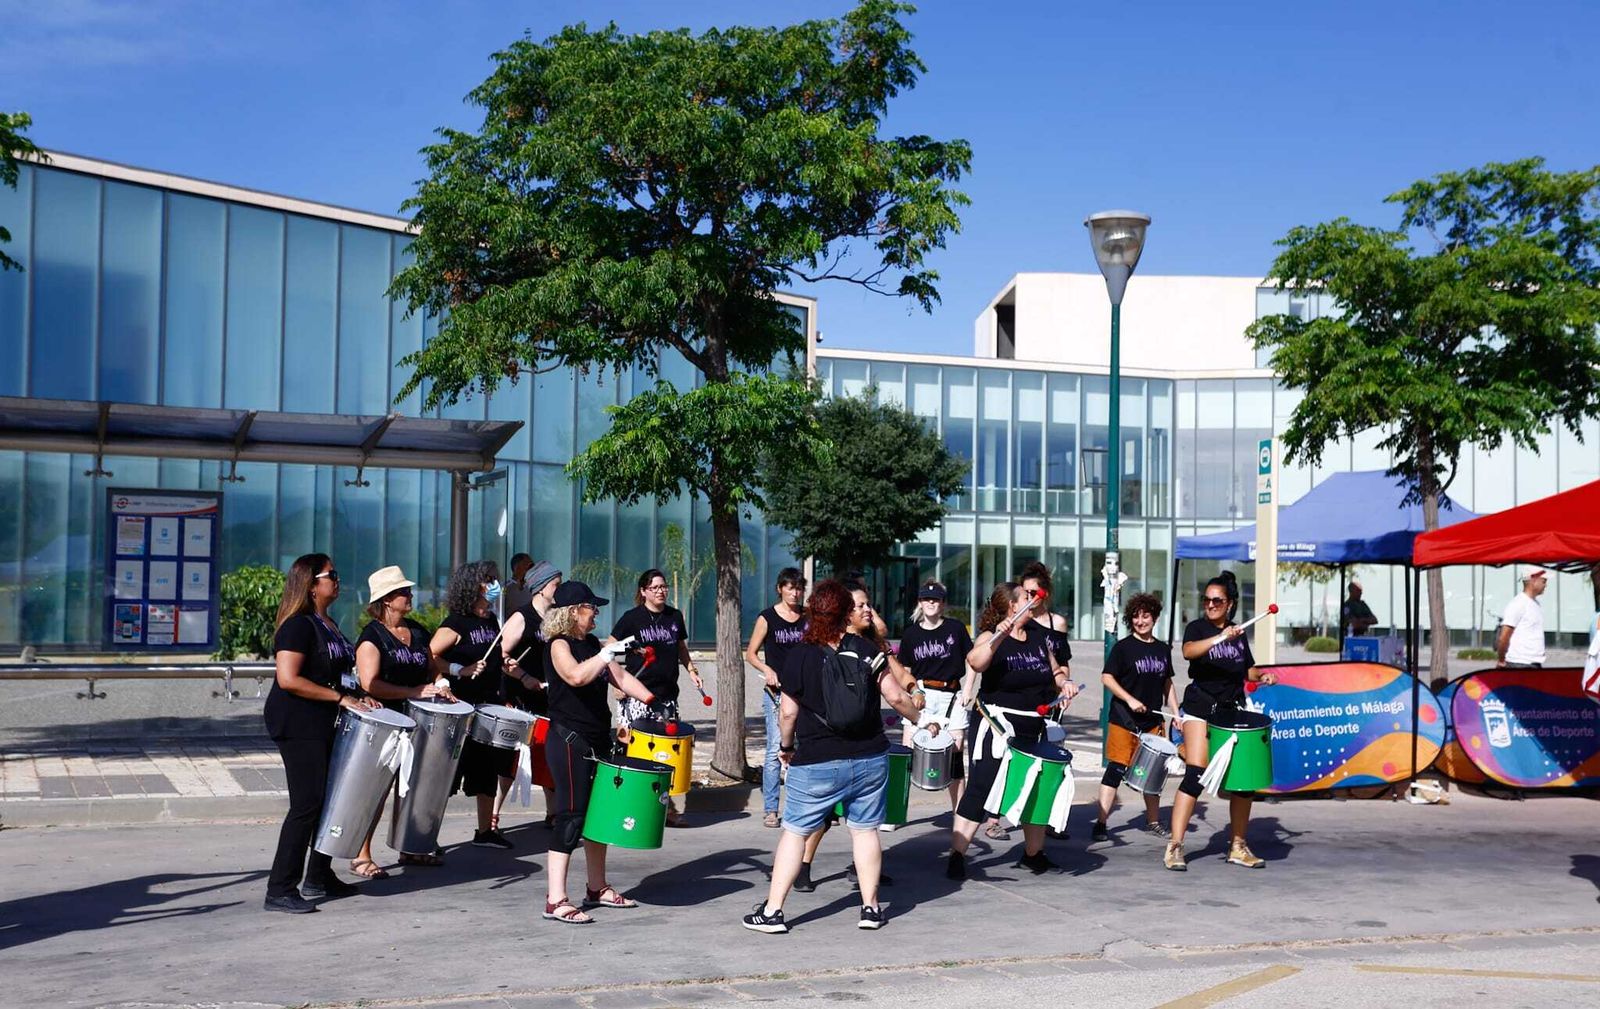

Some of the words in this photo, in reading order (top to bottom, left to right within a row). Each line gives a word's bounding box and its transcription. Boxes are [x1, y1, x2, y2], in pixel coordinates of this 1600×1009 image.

[1269, 705, 1342, 723] Ayuntamiento
[1345, 703, 1360, 716] de
[1362, 700, 1405, 714] Málaga
[1581, 708, 1595, 720] de
[1271, 724, 1296, 740] Área
[1299, 725, 1313, 738] de
[1315, 722, 1360, 738] Deporte
[1538, 726, 1551, 737] de
[1552, 726, 1595, 738] Deporte
